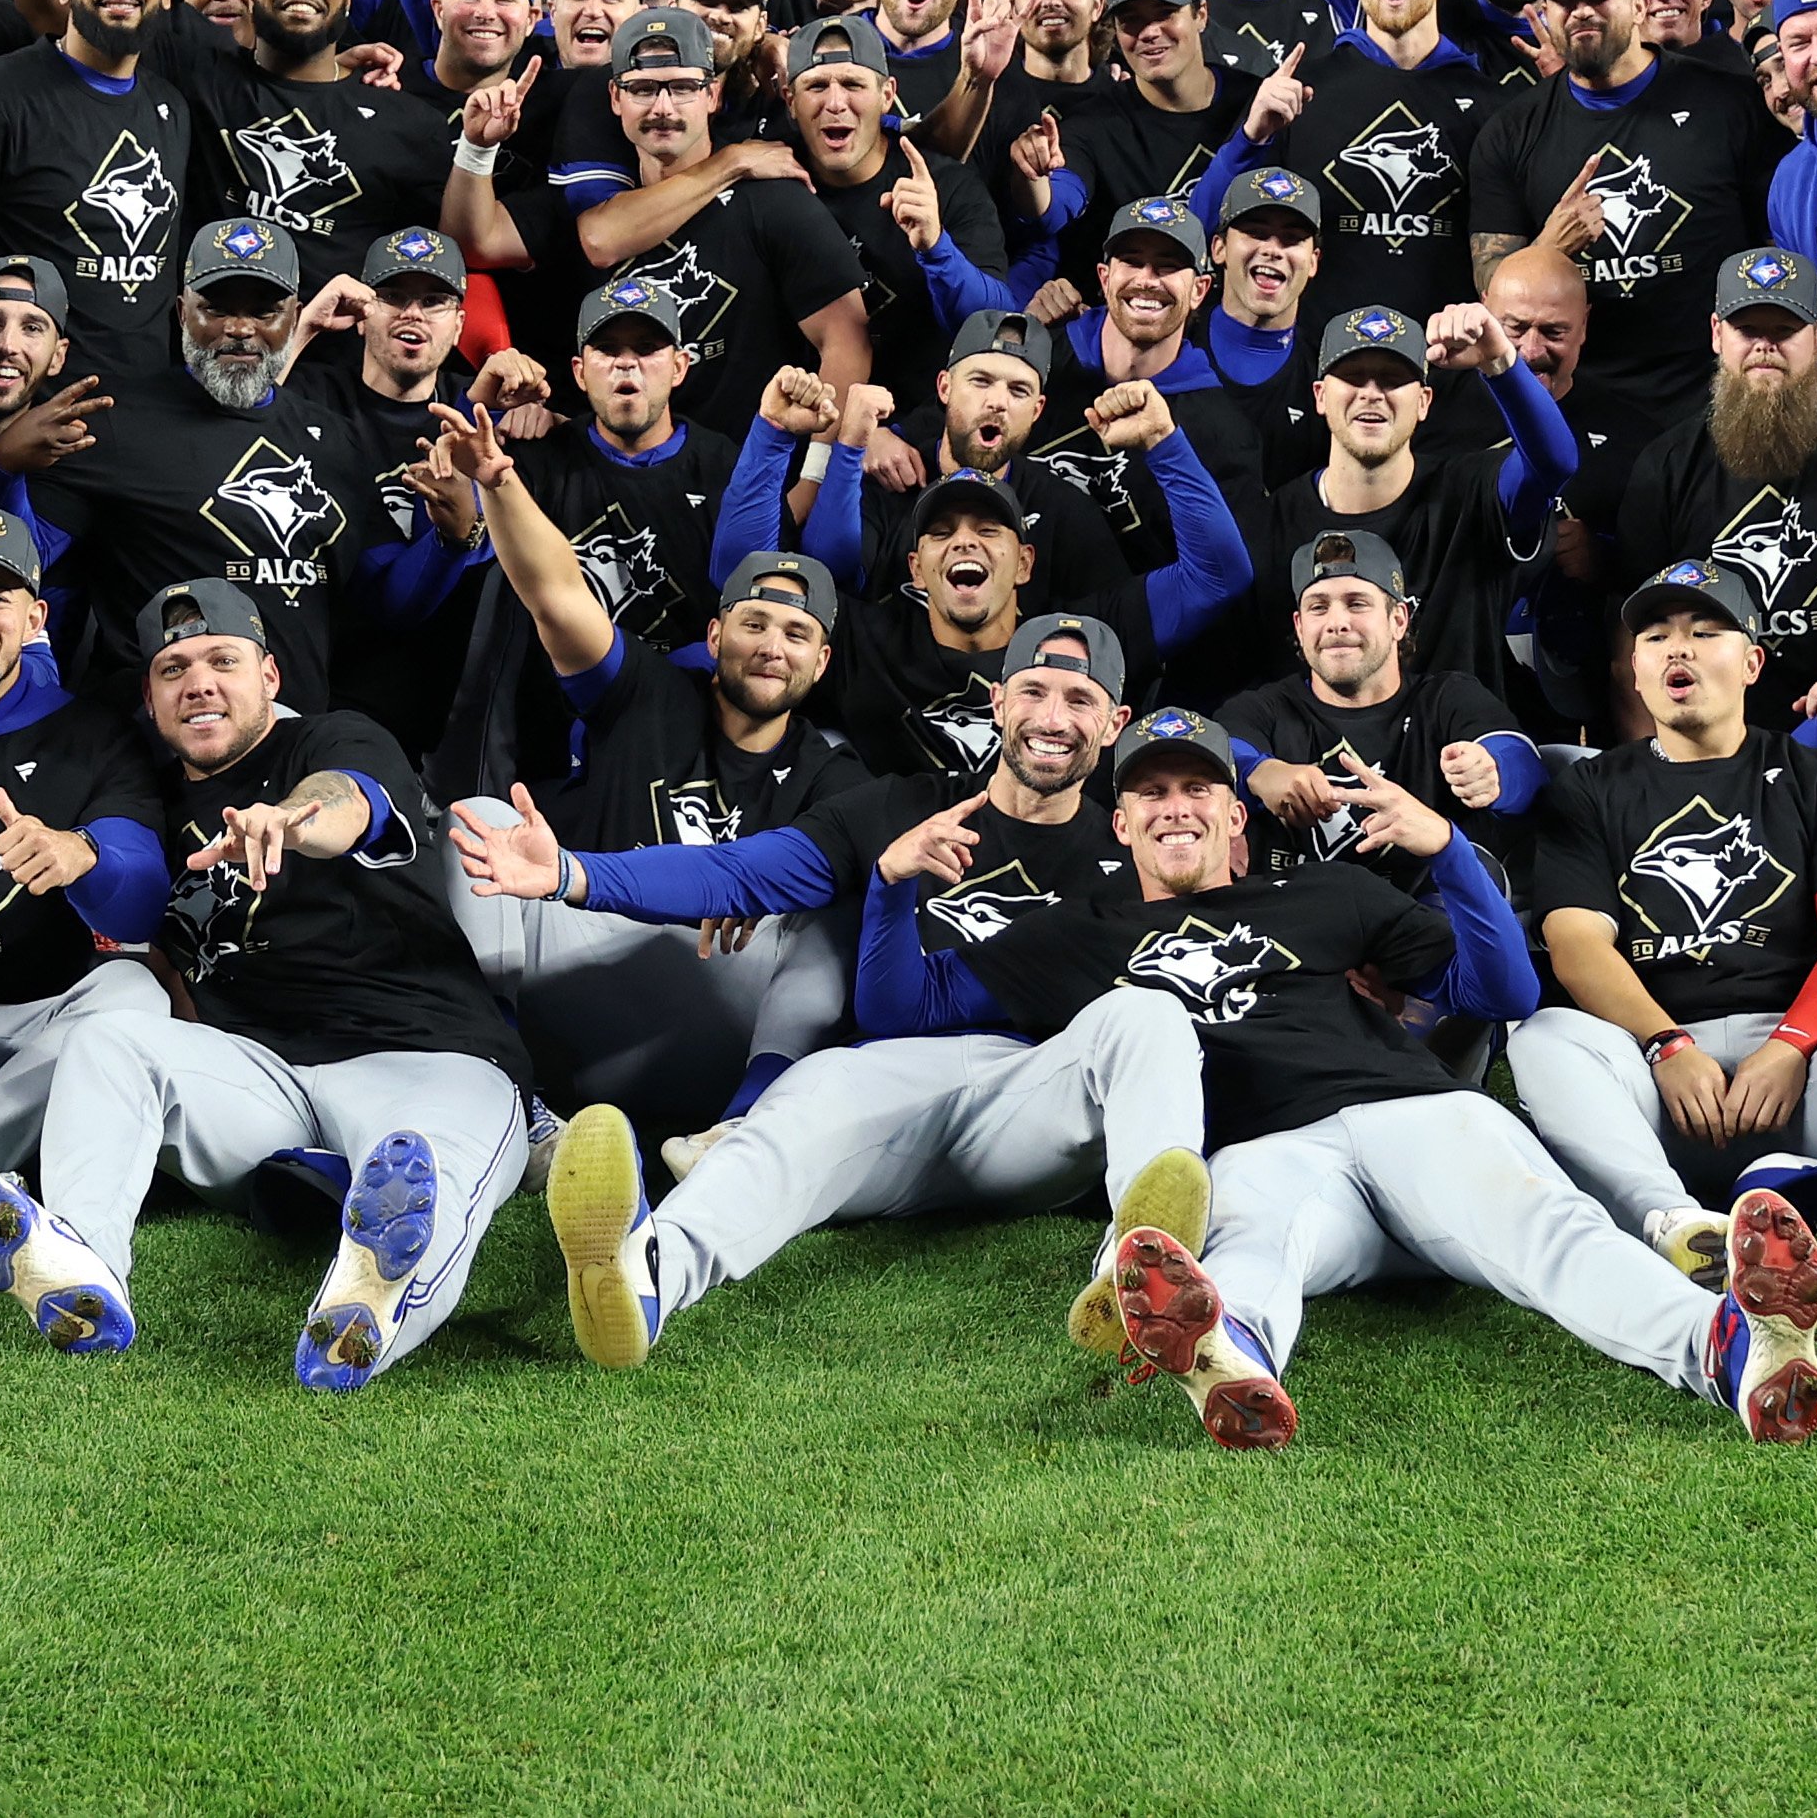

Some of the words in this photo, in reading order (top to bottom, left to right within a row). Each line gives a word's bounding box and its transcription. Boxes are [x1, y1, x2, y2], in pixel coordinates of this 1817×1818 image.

[245, 188, 311, 232] ALCS
[313, 219, 335, 235] 25
[1361, 213, 1430, 237] ALCS
[76, 257, 98, 277] 20
[100, 255, 159, 282] ALCS
[1594, 255, 1659, 282] ALCS
[1662, 254, 1682, 273] 25
[225, 563, 251, 580] 20
[254, 557, 317, 585] ALCS
[1758, 609, 1807, 637] LCS
[1632, 940, 1654, 959] 20
[1657, 922, 1742, 959] ALCS
[1745, 927, 1770, 946] 25
